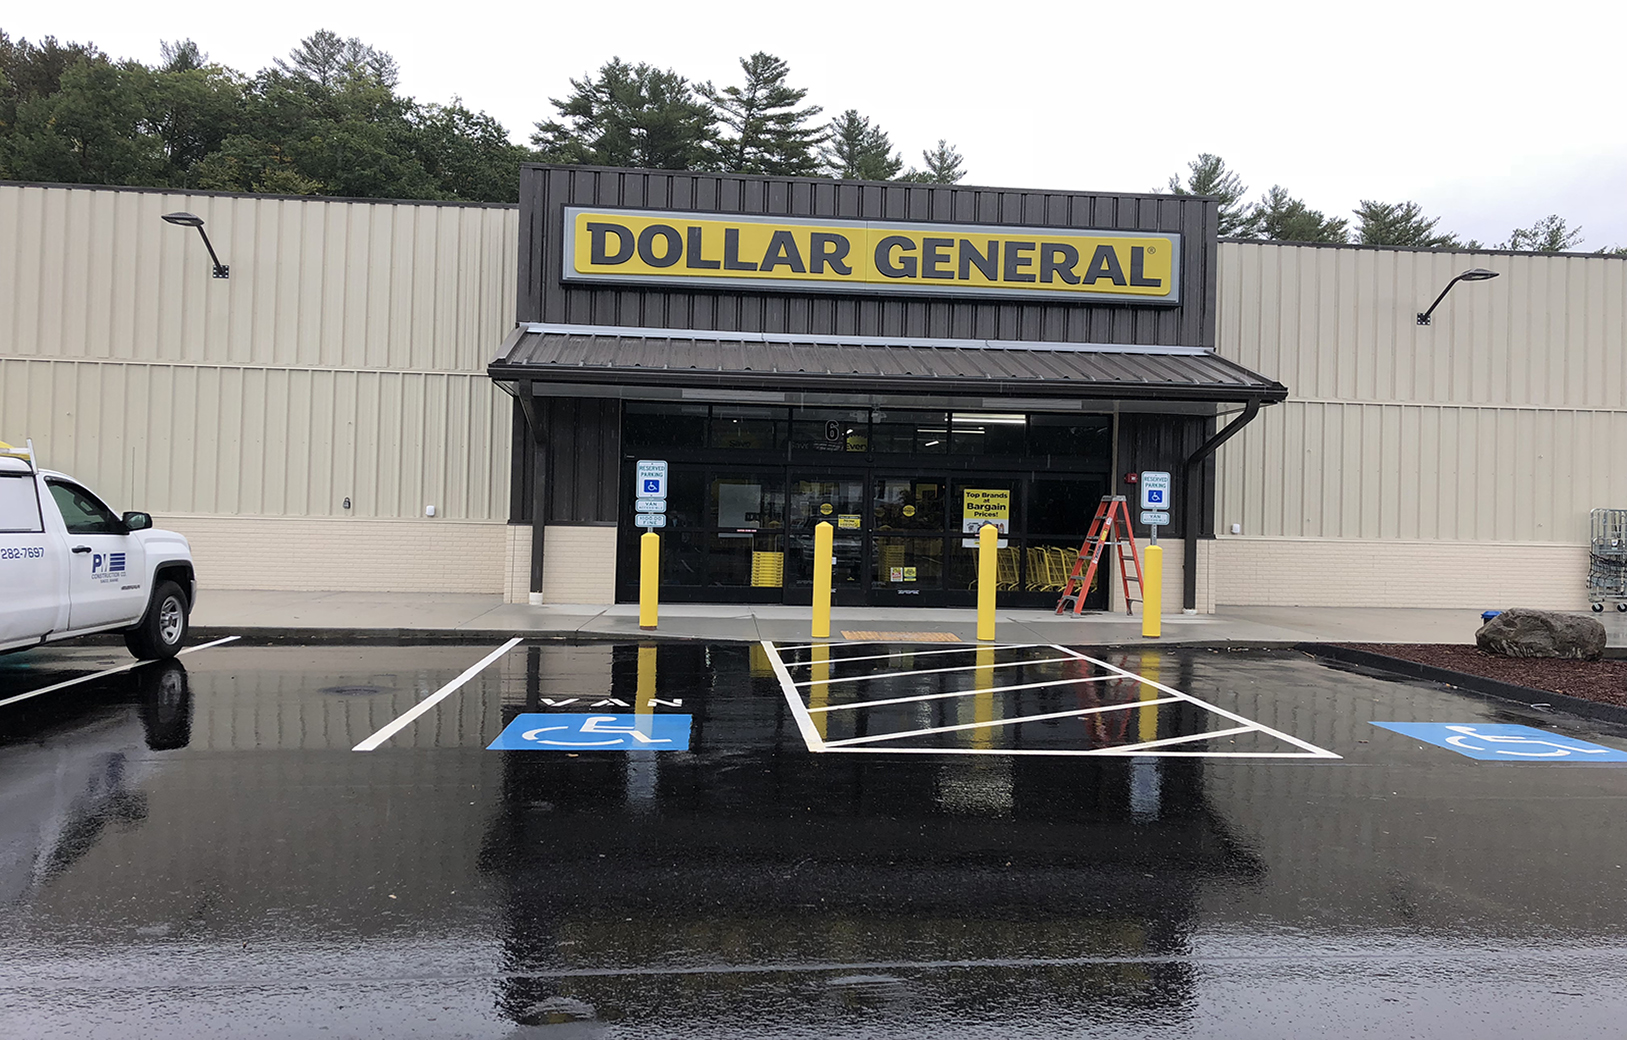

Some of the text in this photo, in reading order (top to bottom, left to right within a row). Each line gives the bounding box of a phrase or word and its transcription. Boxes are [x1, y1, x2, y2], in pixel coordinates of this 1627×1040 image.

[586, 222, 1162, 288] DOLLAR GENERAL
[824, 419, 840, 441] 6
[967, 502, 1006, 511] Bargain
[1, 547, 45, 559] 282-7697
[541, 698, 683, 707] VAN
